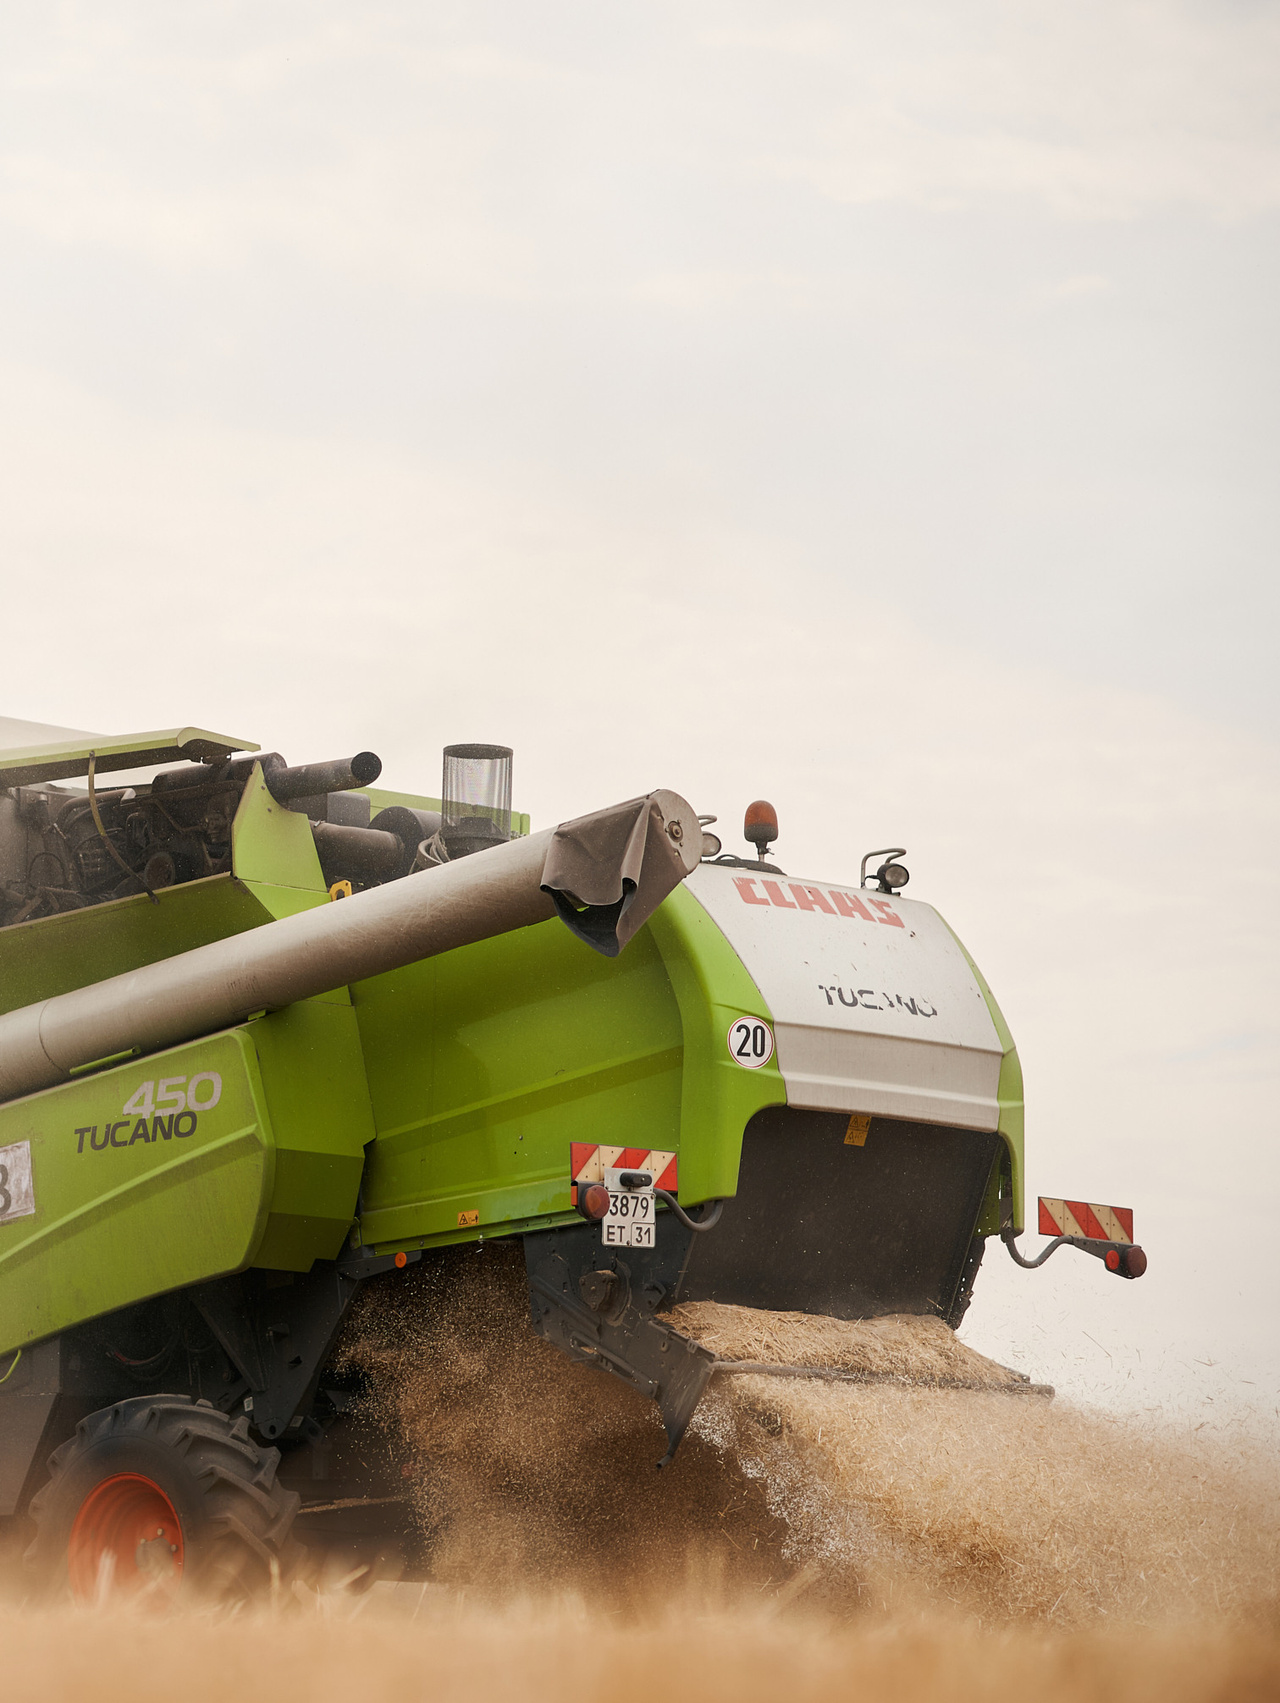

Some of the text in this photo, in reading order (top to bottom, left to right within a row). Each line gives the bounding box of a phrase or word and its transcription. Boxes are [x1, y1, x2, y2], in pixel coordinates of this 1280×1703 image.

[731, 877, 905, 928] CLAAS
[736, 1024, 766, 1057] 20
[122, 1071, 223, 1119] 450
[74, 1111, 197, 1153] TUCANO
[609, 1194, 649, 1218] 3879
[635, 1226, 651, 1245] 31
